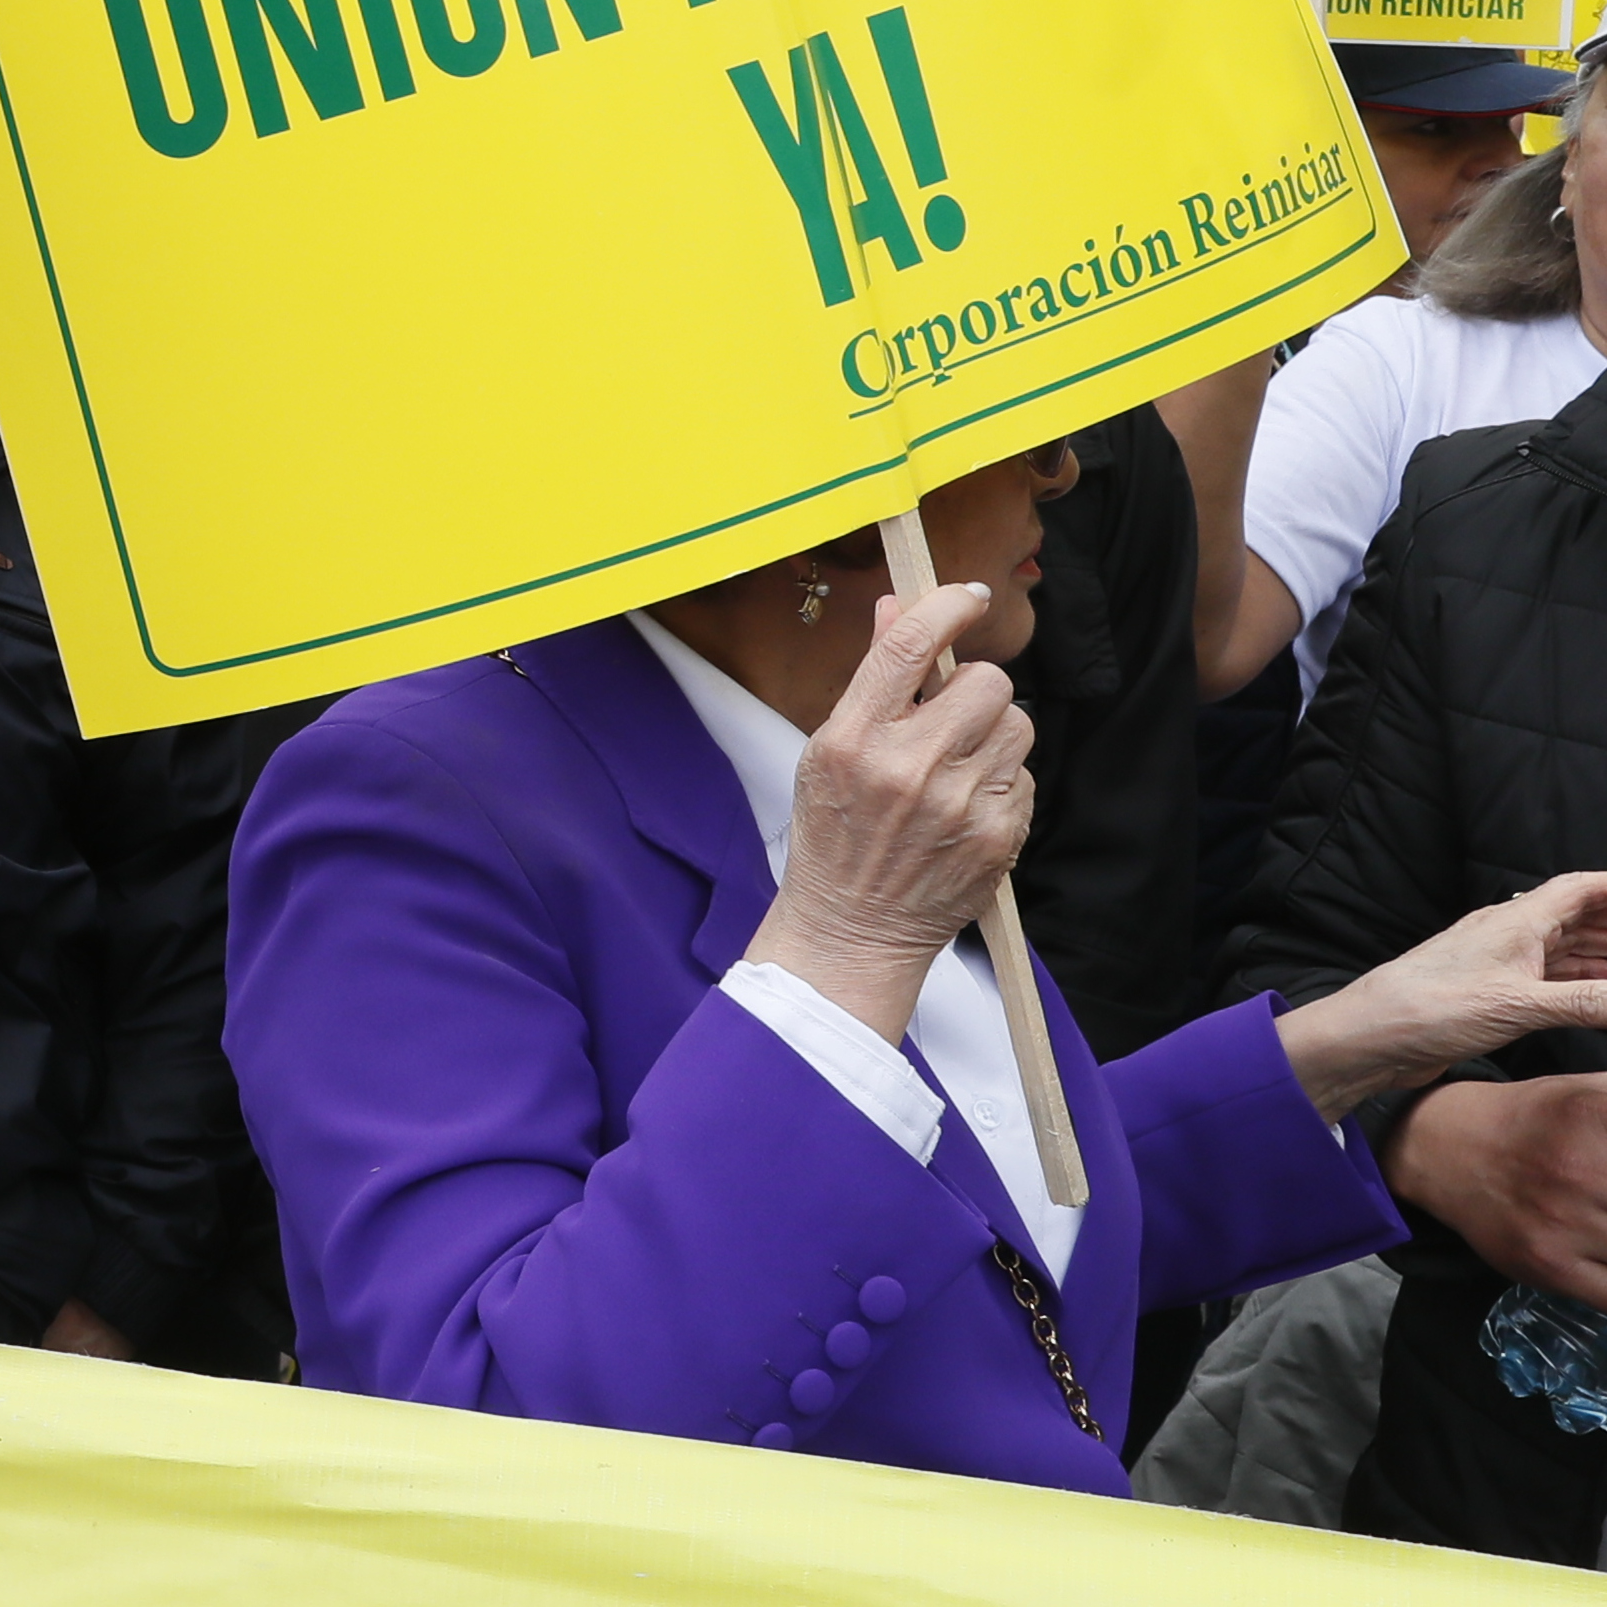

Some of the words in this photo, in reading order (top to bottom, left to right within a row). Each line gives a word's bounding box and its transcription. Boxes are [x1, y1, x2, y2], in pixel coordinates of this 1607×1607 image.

[724, 5, 968, 307] YA!
[839, 225, 1180, 405] Corporación
[1178, 140, 1349, 275] Reiniciar
